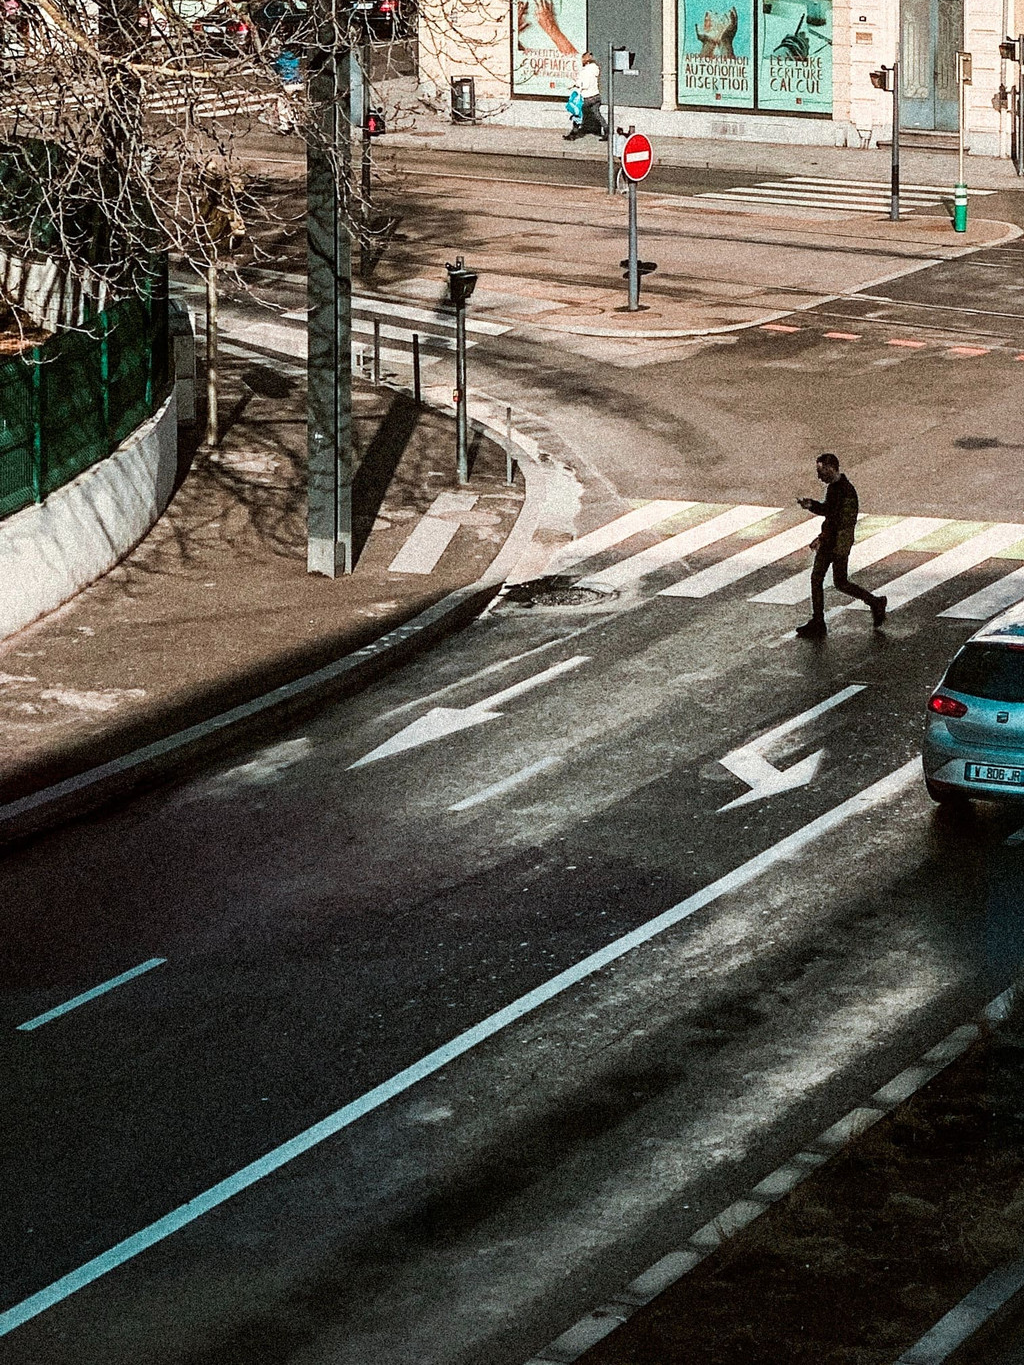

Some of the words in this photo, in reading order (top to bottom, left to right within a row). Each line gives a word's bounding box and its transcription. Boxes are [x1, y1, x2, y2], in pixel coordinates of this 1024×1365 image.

[685, 52, 749, 66] APPROPRIATION
[769, 54, 823, 69] LECTURE
[685, 63, 748, 78] AUTONOMIE
[770, 66, 824, 81] ECRITURE
[685, 75, 749, 91] INSERTION
[770, 78, 823, 95] CALCUL
